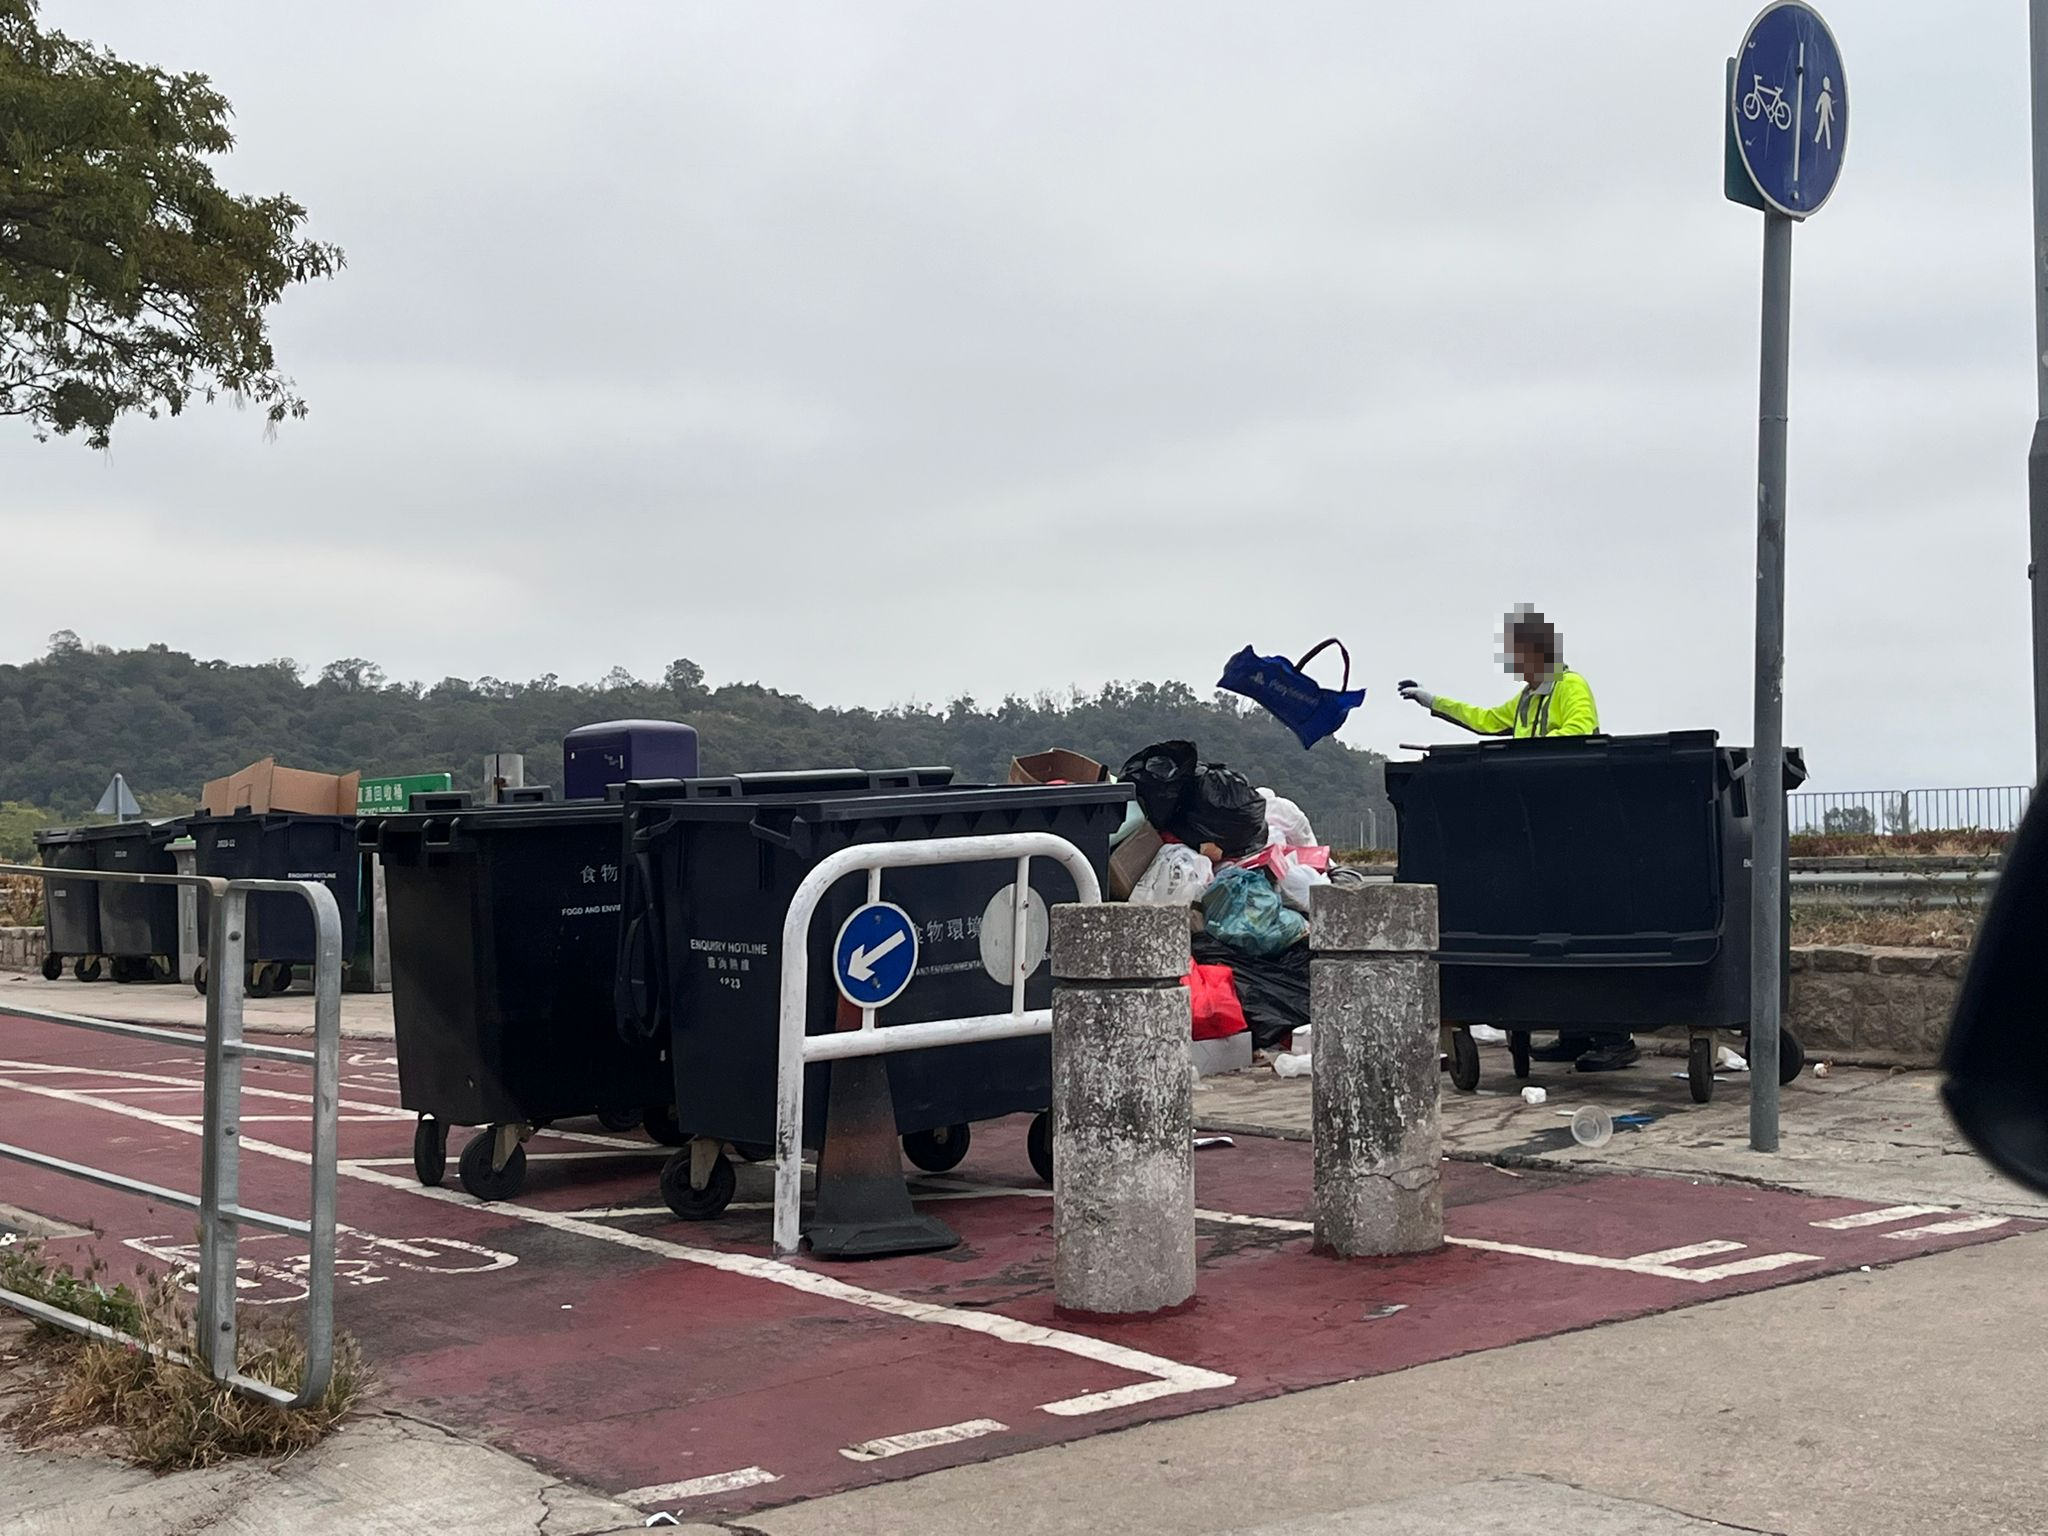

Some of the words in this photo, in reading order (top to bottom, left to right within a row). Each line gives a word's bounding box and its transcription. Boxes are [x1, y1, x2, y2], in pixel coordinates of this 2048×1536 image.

[580, 864, 618, 883] 食物
[561, 907, 584, 916] FOOD
[584, 905, 601, 914] AND
[690, 939, 726, 952] ENQUIRY
[727, 942, 768, 955] HOTLINE
